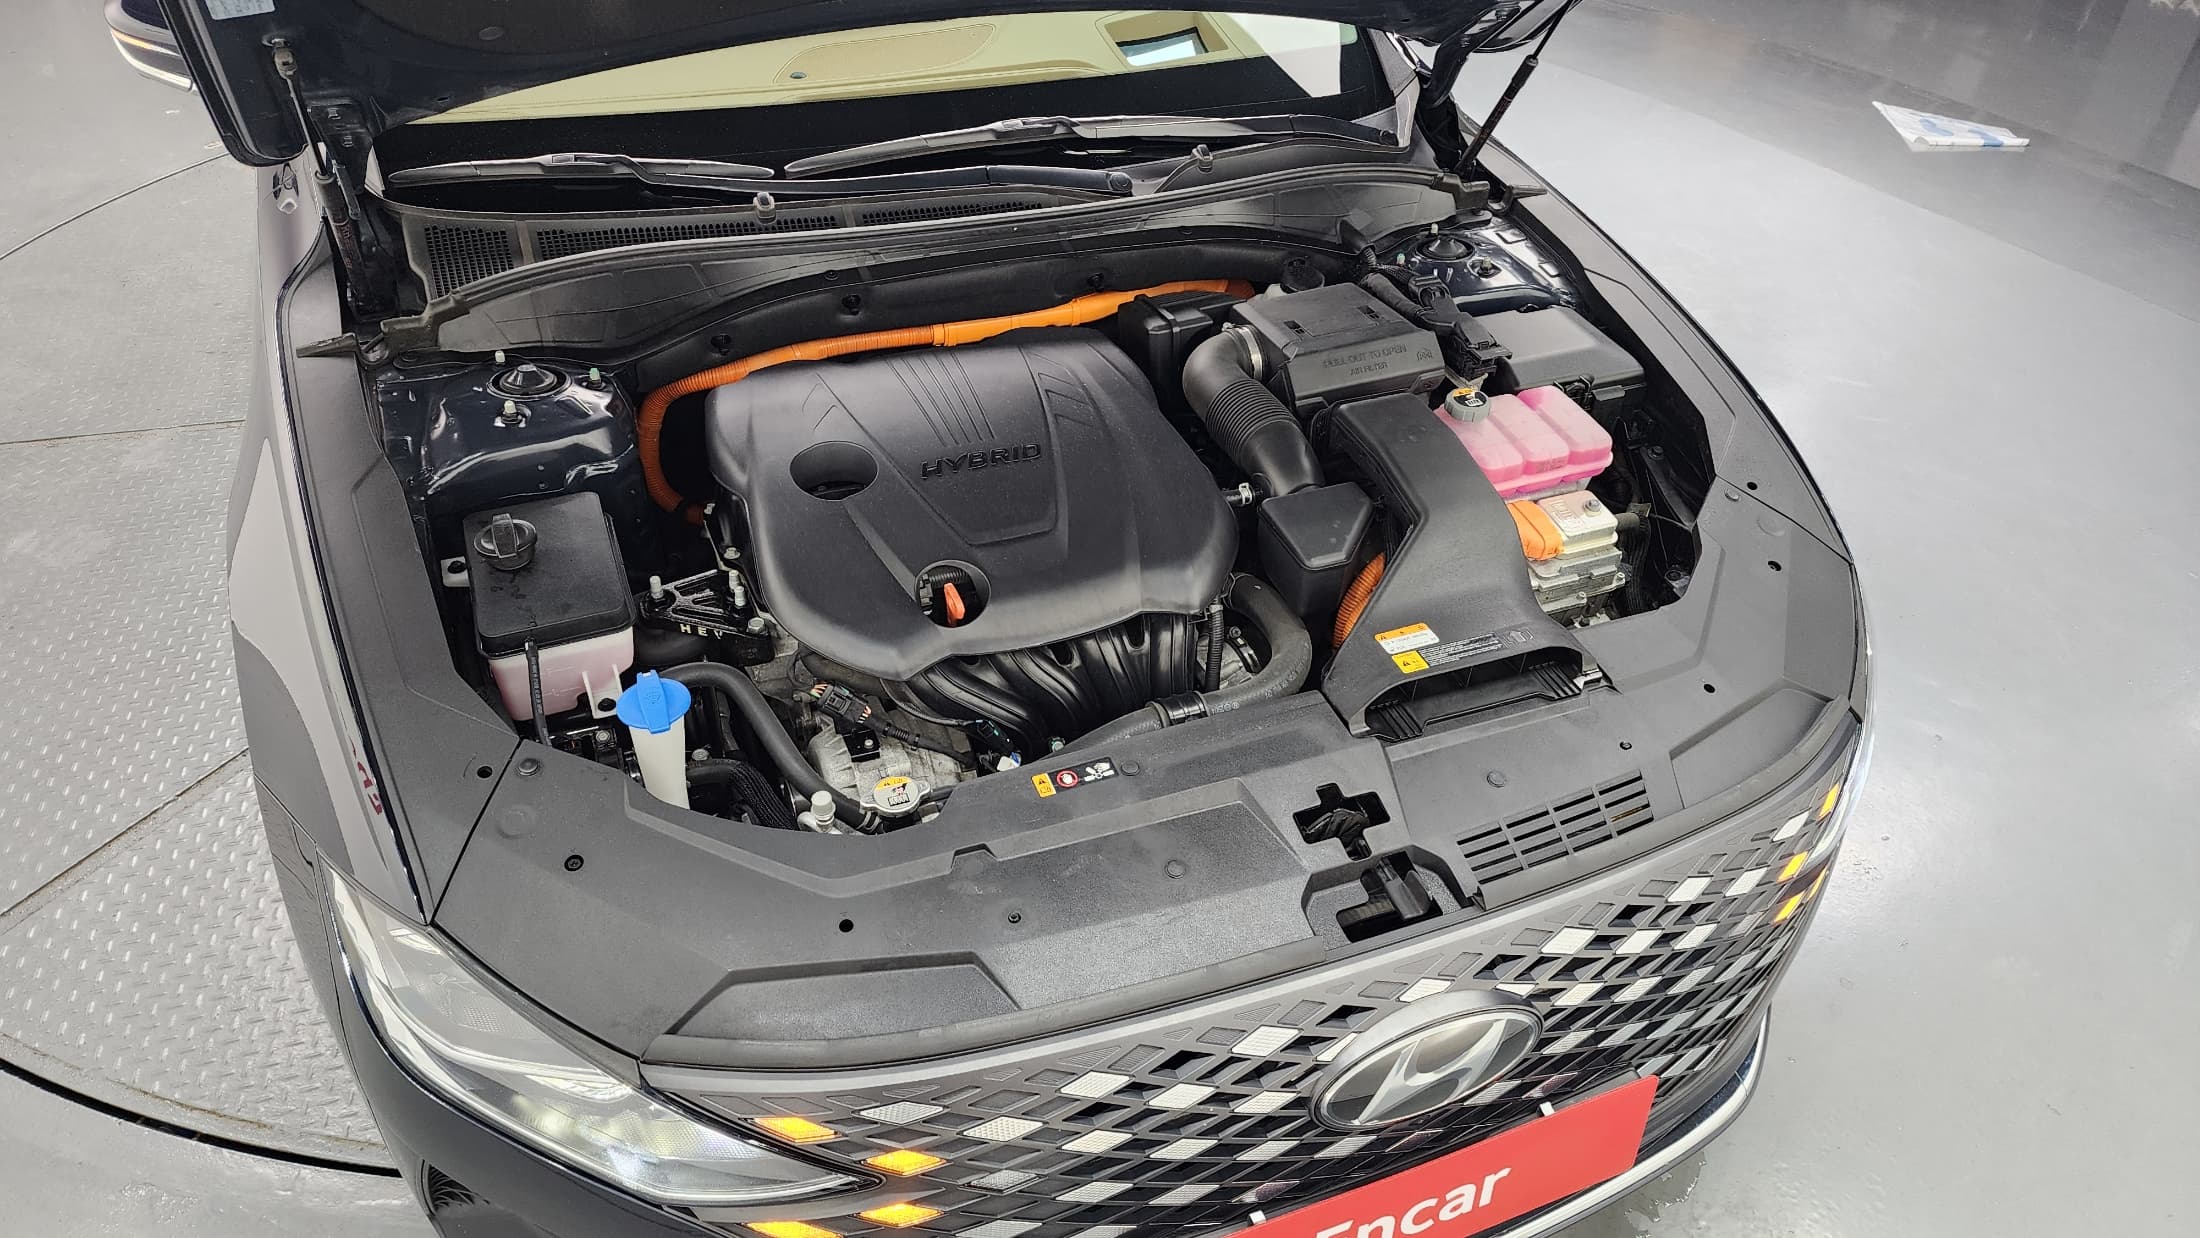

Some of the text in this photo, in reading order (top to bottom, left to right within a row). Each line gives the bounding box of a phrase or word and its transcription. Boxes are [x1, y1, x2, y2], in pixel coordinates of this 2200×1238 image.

[1348, 351, 1367, 363] OUT
[1369, 349, 1381, 359] TO
[1382, 343, 1407, 357] OPEN
[919, 443, 1042, 480] HYBRID
[679, 623, 724, 640] HEV
